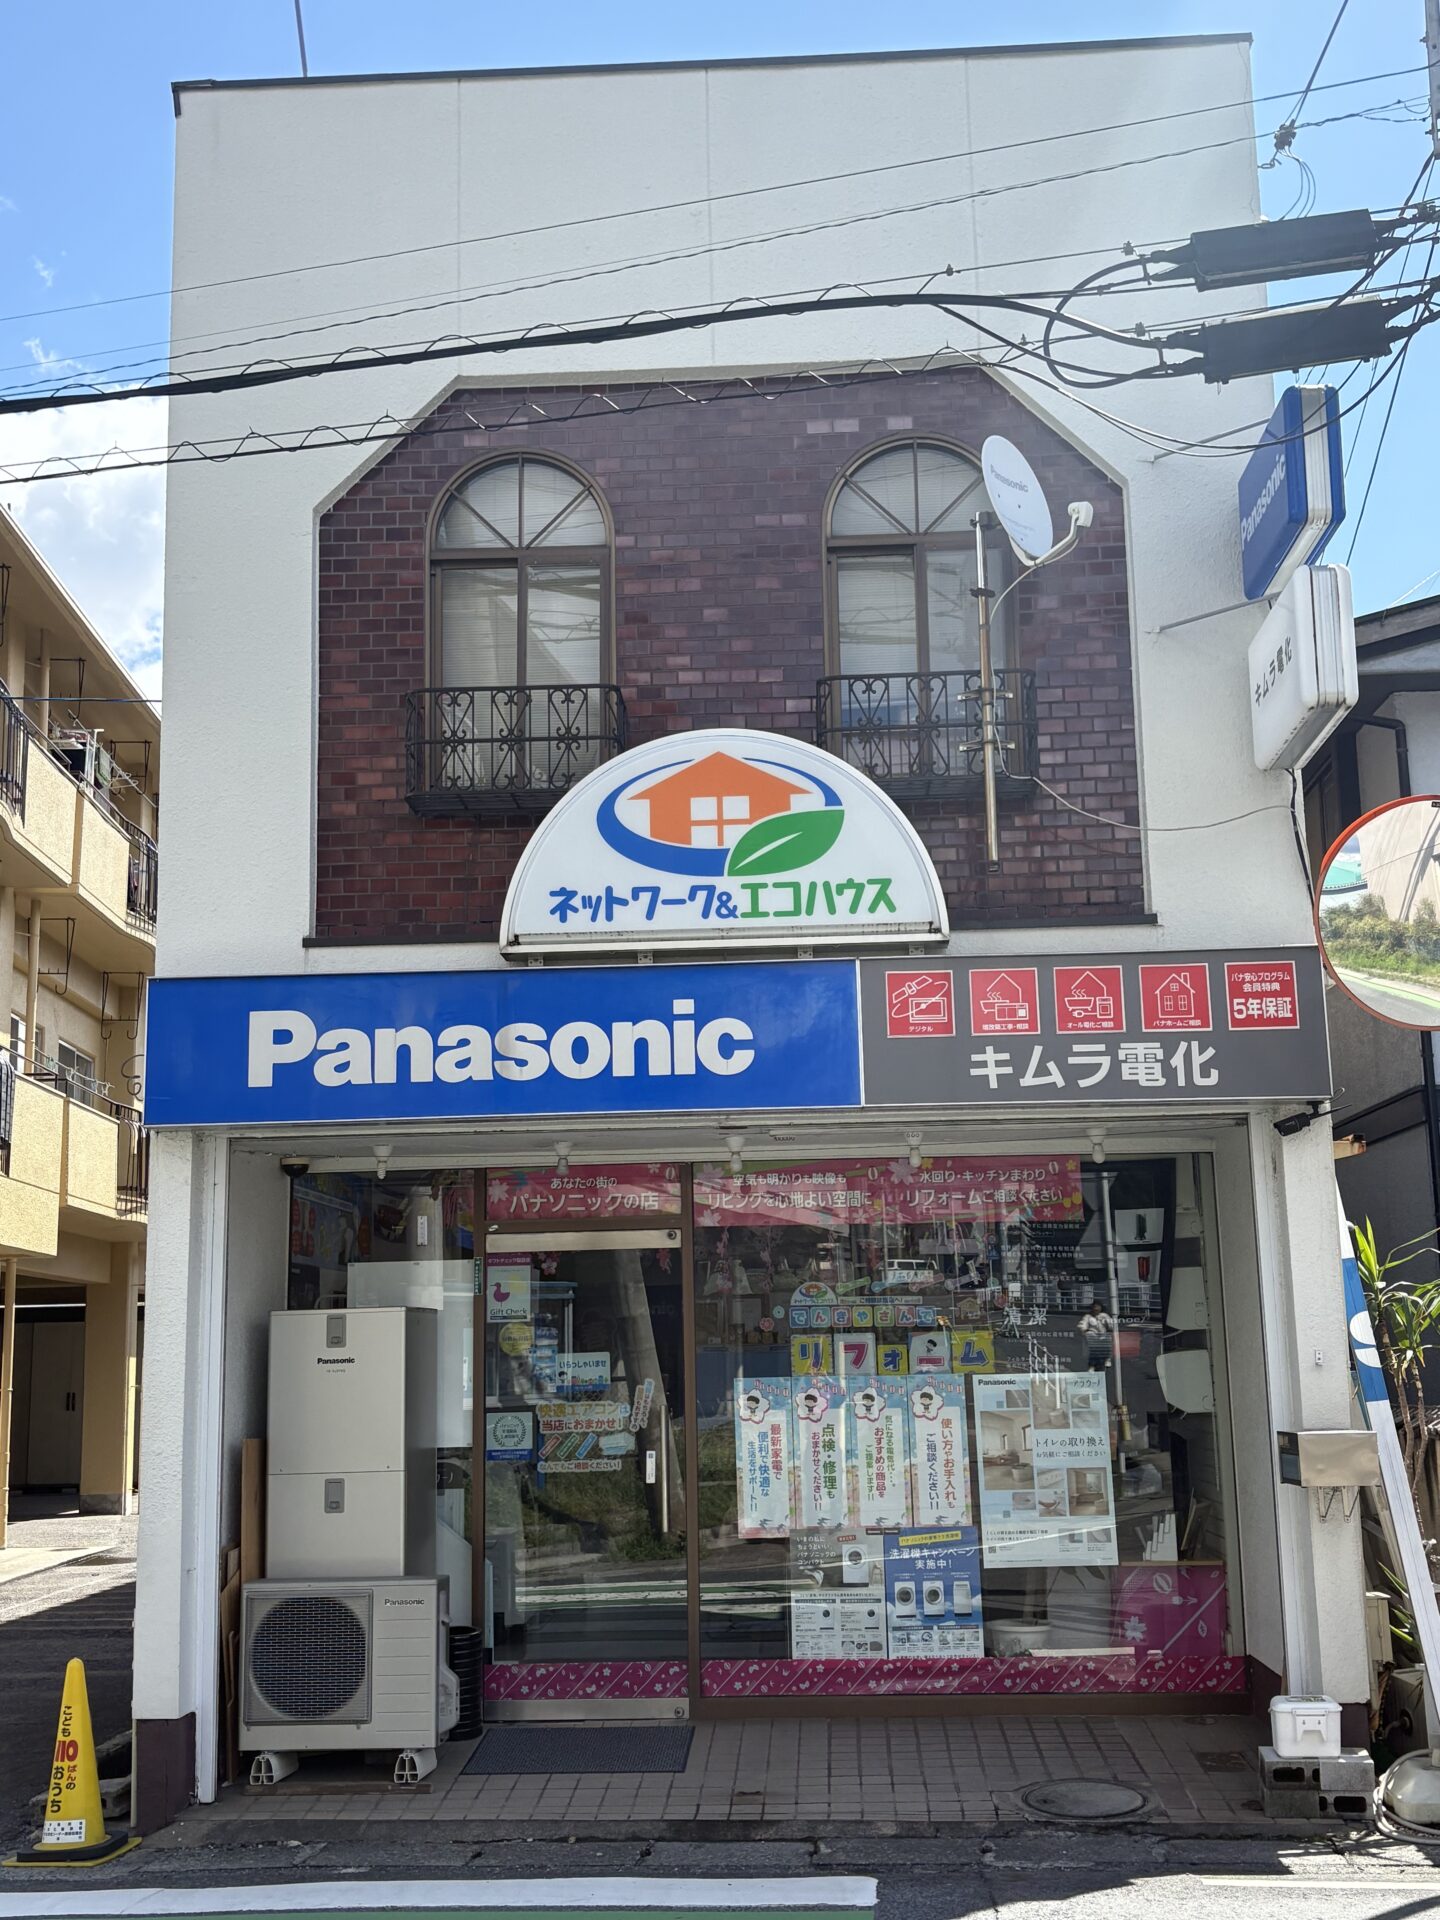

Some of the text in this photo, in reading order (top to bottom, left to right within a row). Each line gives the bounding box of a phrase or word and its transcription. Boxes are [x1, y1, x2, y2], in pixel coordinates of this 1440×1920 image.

[990, 463, 1029, 493] Panasonic
[1240, 453, 1286, 551] Panasonic
[1254, 636, 1293, 706] キムラ電化
[548, 878, 896, 923] ネットワーク&エコハウス
[1231, 972, 1290, 981] パナ安心プログラム
[1242, 982, 1281, 993] 会員特典
[1233, 997, 1293, 1019] 5年保証
[908, 1025, 934, 1033] デジタル
[247, 998, 756, 1088] Panasonic
[970, 1040, 1219, 1089] キムラ電化
[550, 1176, 617, 1189] あなたの街の
[732, 1173, 847, 1186] 空気も明かりも映像も
[919, 1168, 1046, 1183] 水回り・キッチンまわり
[509, 1192, 659, 1213] パナソニックの店
[708, 1190, 872, 1210] リビングを心地よい空間に
[906, 1187, 1063, 1206] リフォームご相談ください
[490, 1307, 504, 1316] Gift
[792, 1307, 935, 1323] でんきやさんで
[317, 1355, 355, 1365] Panasonic
[559, 1359, 606, 1369] いらっしゃいませ
[799, 1341, 989, 1371] リフォーム
[978, 1378, 1017, 1386] Panasonic
[538, 1403, 629, 1417] 快適エアコンは
[541, 1417, 623, 1432] 当店におまかせ!
[769, 1423, 783, 1481] 最新家電で
[1035, 1437, 1105, 1448] トイレの取り換え
[757, 1431, 771, 1497] 便利で快適な
[821, 1423, 838, 1499] 点検・修理も
[874, 1426, 887, 1499] おすすめの商品を
[941, 1418, 957, 1509] 使い方やお手入れも
[1036, 1450, 1106, 1459] お気軽にご相談ください
[796, 1551, 836, 1559] パナソニックの
[889, 1548, 976, 1560] 洗濯機キャンペーン
[914, 1559, 953, 1570] 実施中!
[384, 1597, 425, 1606] Panasonic
[61, 1705, 72, 1737] こども
[54, 1739, 79, 1762] 110
[65, 1764, 78, 1791] ばんの
[50, 1765, 65, 1813] おうち
